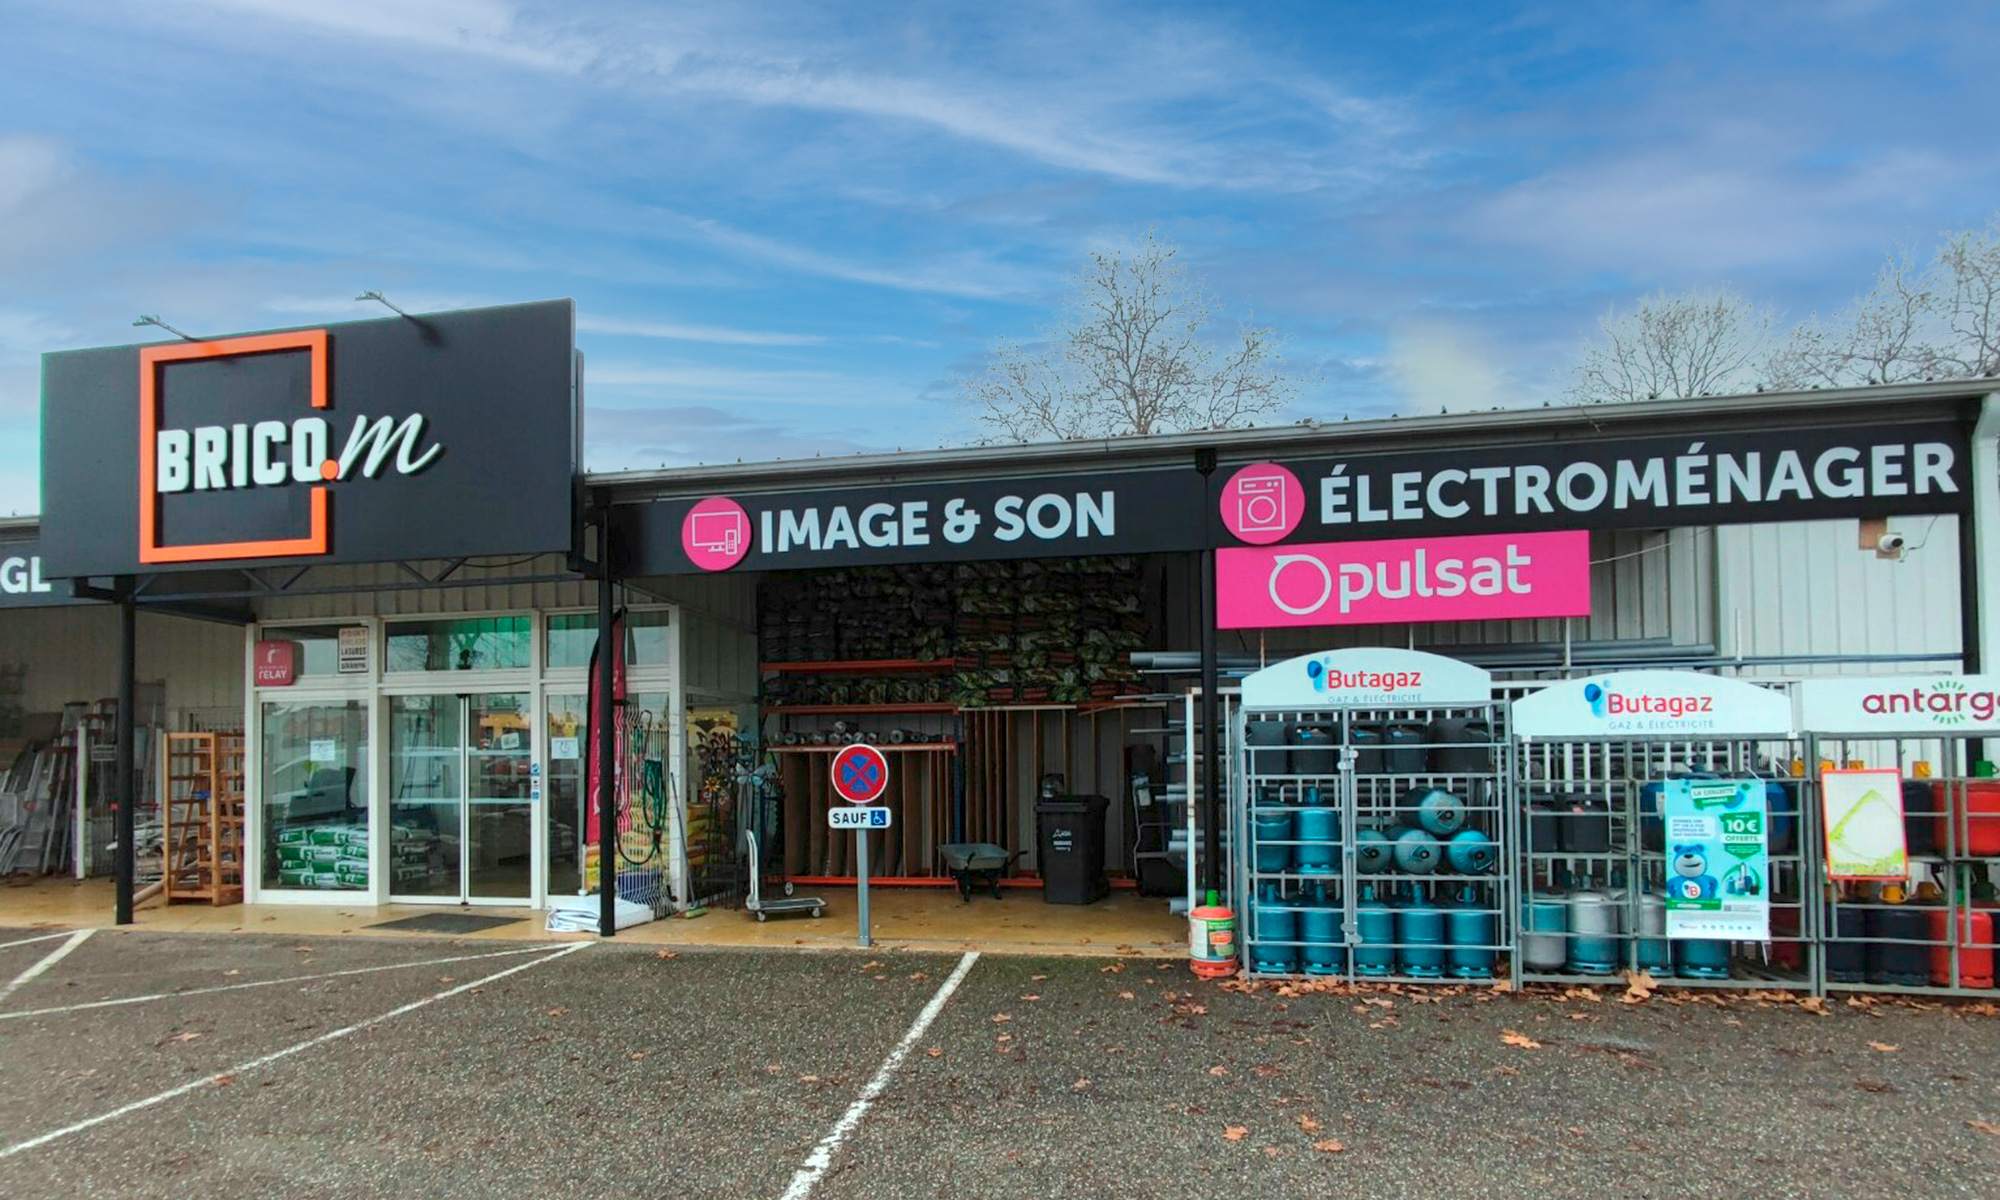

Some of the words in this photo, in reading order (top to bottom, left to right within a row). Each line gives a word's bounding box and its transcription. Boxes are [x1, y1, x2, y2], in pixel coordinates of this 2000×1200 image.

[1320, 442, 1959, 525] ÉLECTROMÉNAGER
[761, 501, 930, 554] IMAGE
[943, 498, 980, 543] &
[994, 491, 1115, 542] SON
[1328, 669, 1422, 691] Butagaz
[1608, 693, 1713, 718] Butagaz
[1862, 688, 2000, 721] antarg
[1609, 721, 1631, 730] GAZ
[1637, 721, 1644, 729] &
[1649, 719, 1714, 729] ÉLECTRICITÉ
[832, 812, 867, 824] SAUF
